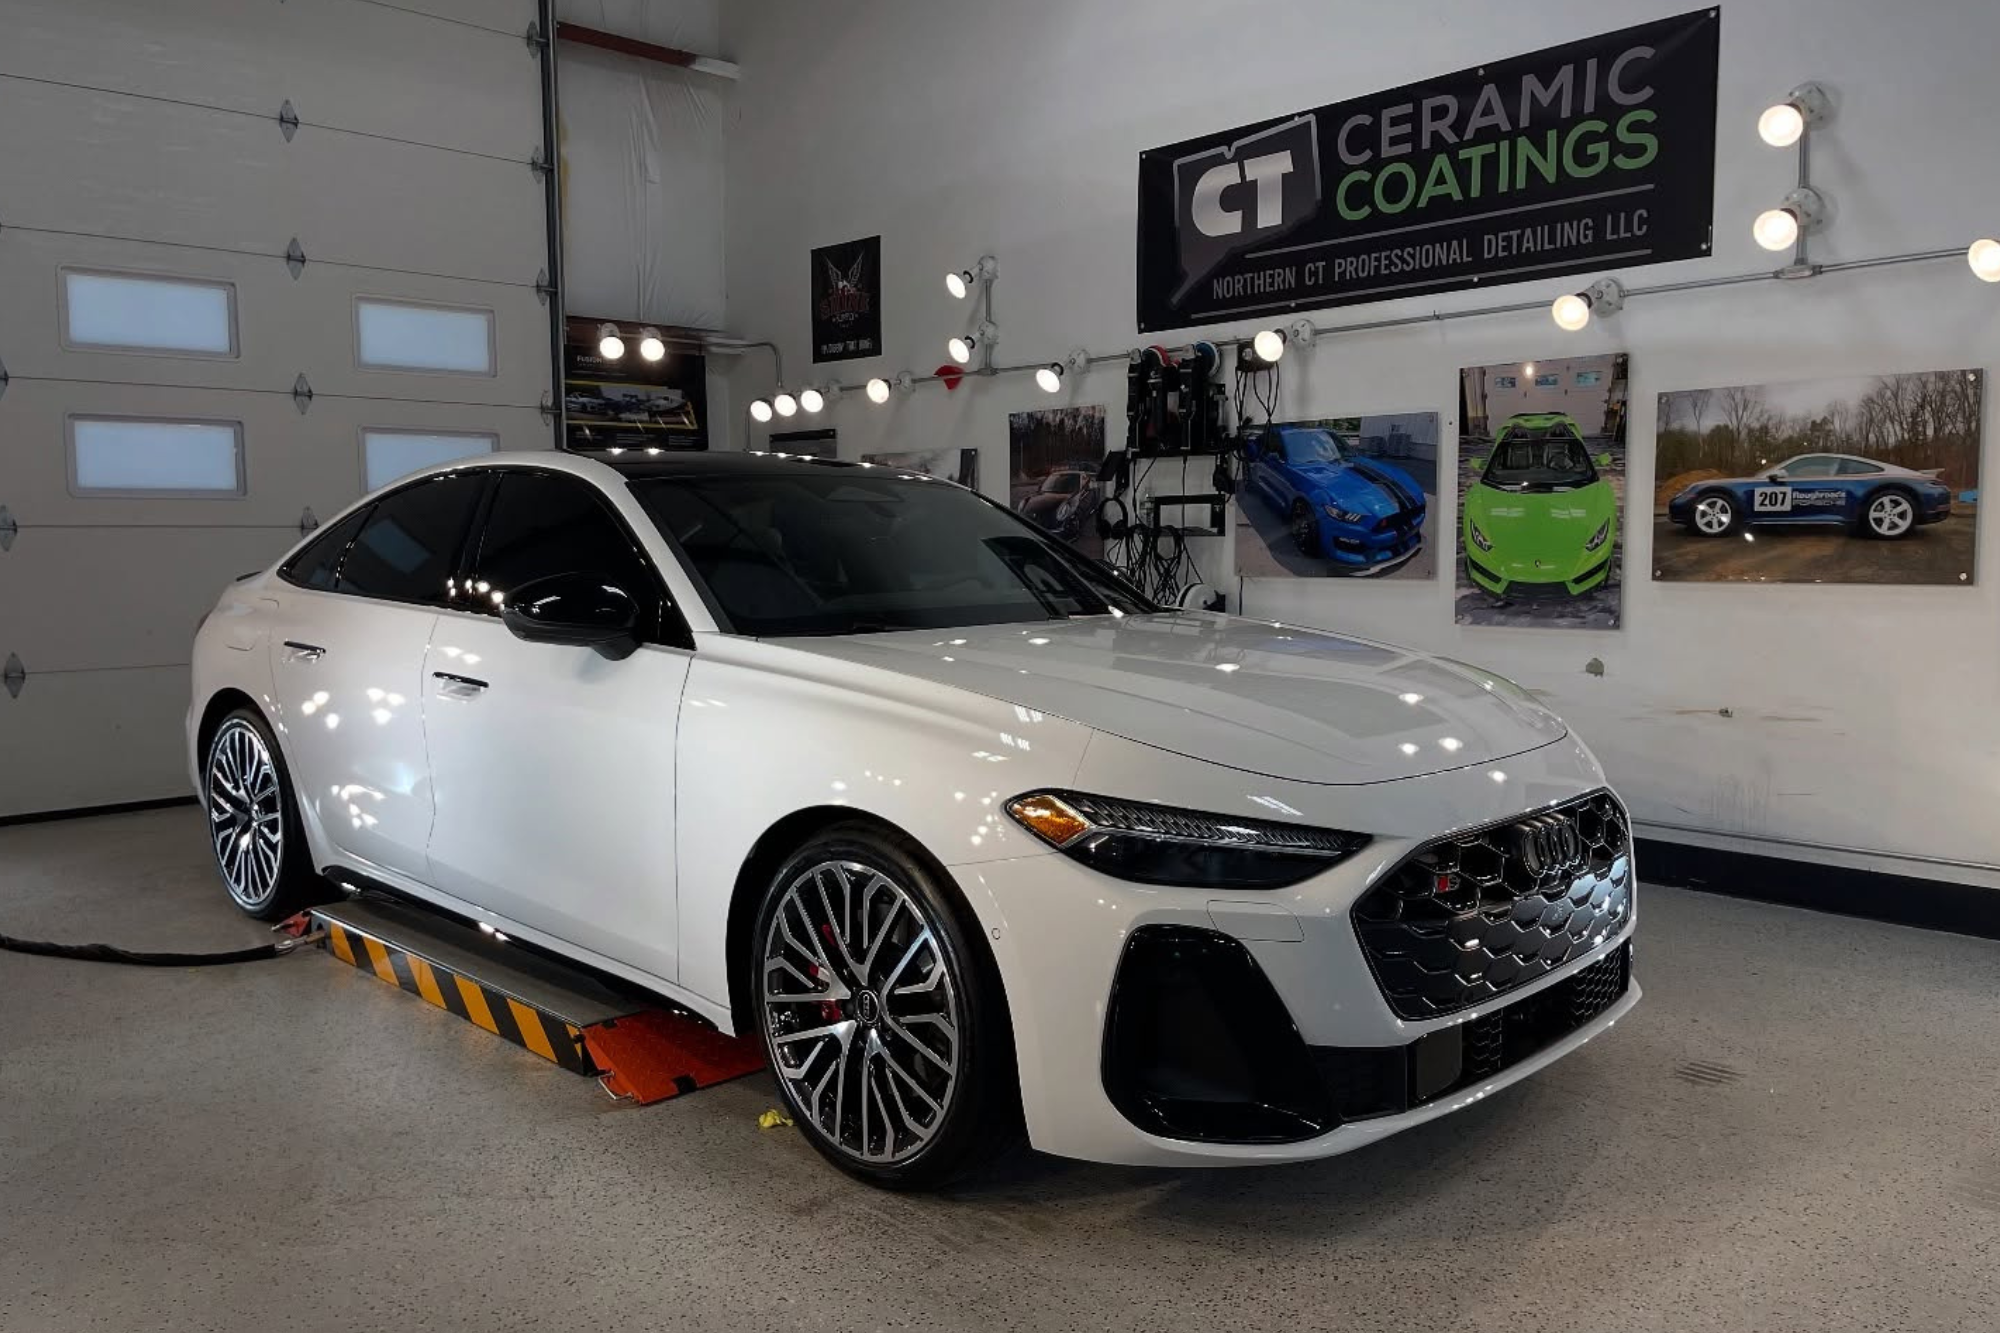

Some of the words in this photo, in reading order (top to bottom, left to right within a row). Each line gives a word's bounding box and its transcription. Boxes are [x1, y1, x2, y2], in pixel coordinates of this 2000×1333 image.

[1337, 45, 1656, 166] CERAMIC
[1191, 150, 1294, 238] CT
[1336, 109, 1659, 221] COATINGS
[1213, 267, 1297, 300] NORTHERN
[1304, 261, 1326, 286] CT
[1334, 238, 1473, 282] PROFESSIONAL
[1483, 217, 1594, 260] DETAILING
[1606, 208, 1649, 241] LLC
[1758, 491, 1787, 507] 207
